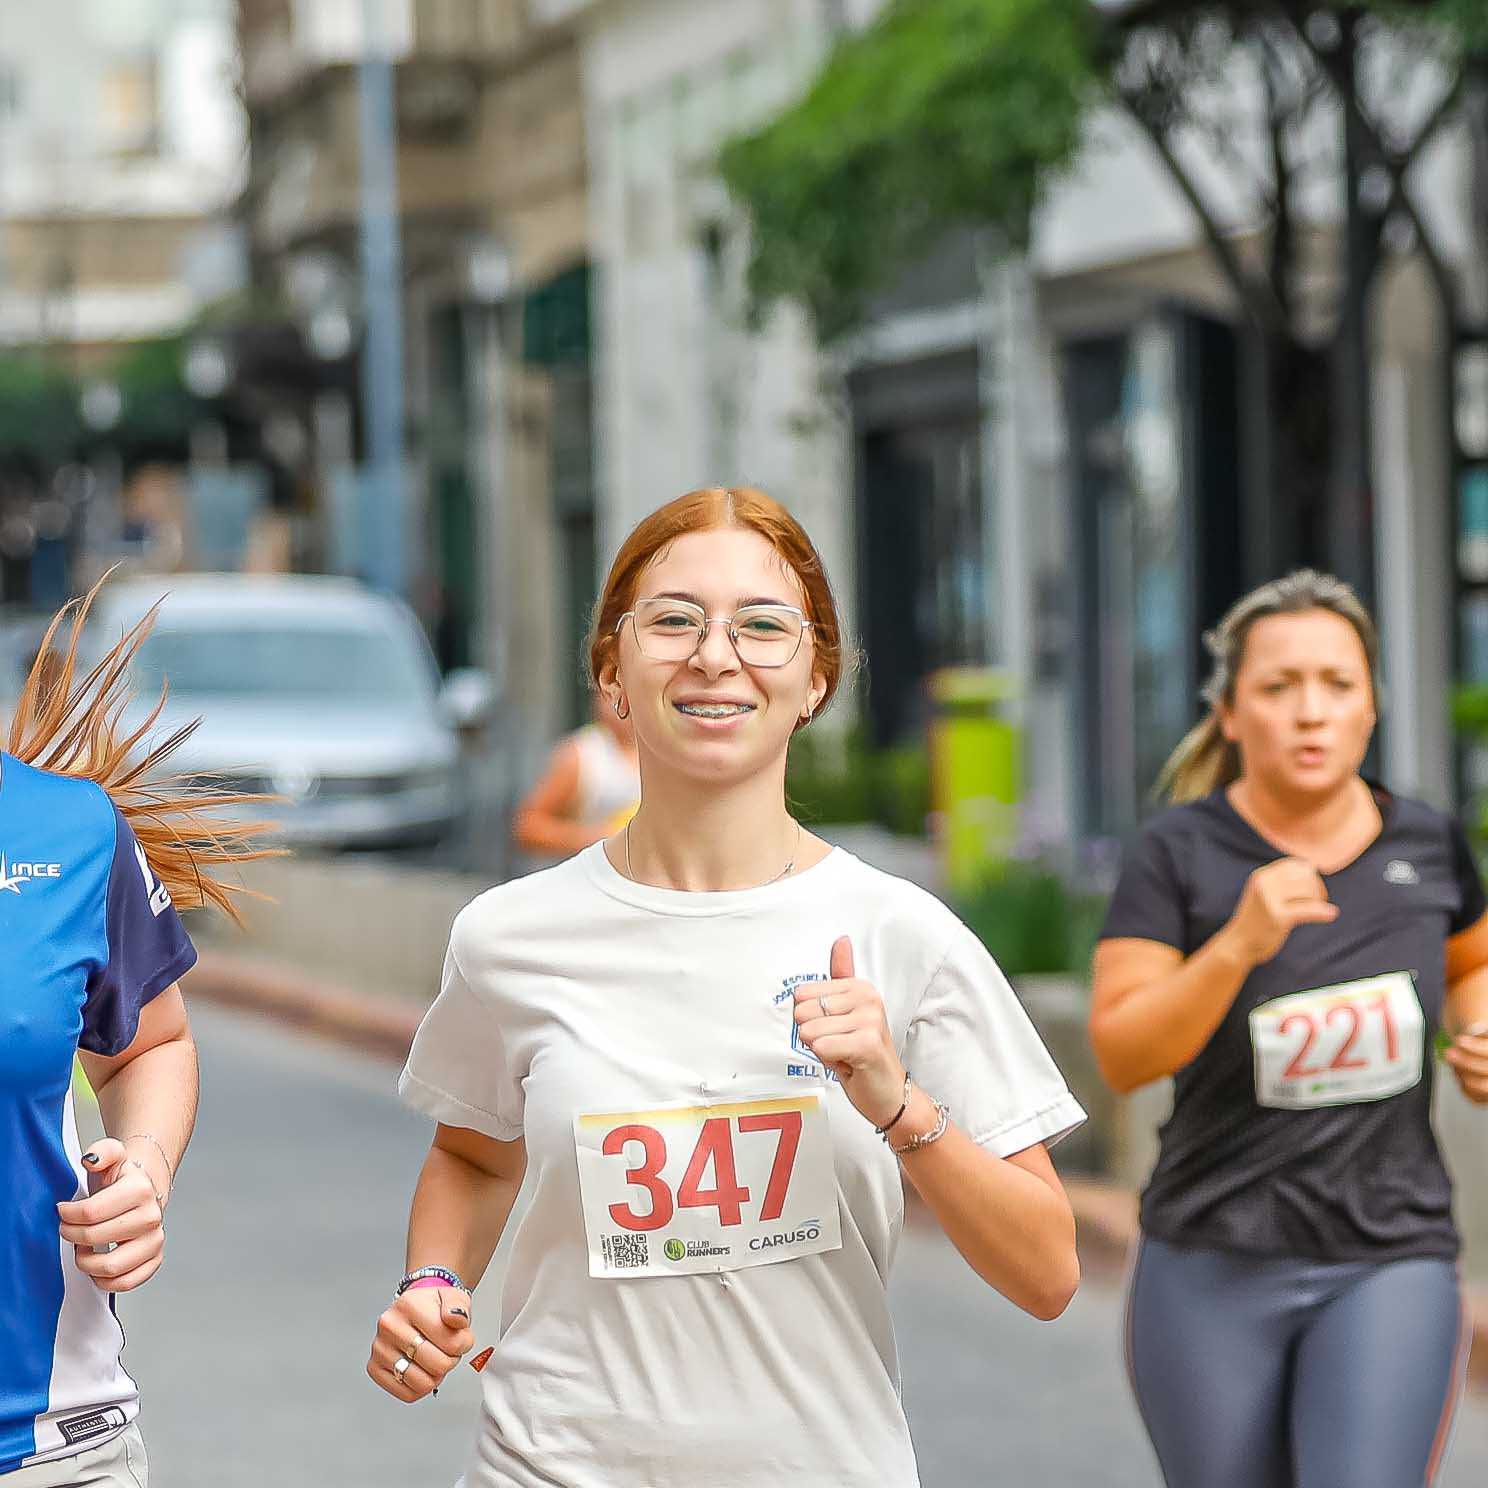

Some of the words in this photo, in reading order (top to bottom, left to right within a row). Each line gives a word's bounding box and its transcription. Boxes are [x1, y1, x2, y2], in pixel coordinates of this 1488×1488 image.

[1278, 992, 1400, 1078] 221
[787, 1064, 820, 1078] BELL
[602, 1111, 802, 1231] 347
[687, 1240, 710, 1249] CLUB
[749, 1228, 820, 1250] CARUSO
[686, 1247, 731, 1257] RUNNER'S
